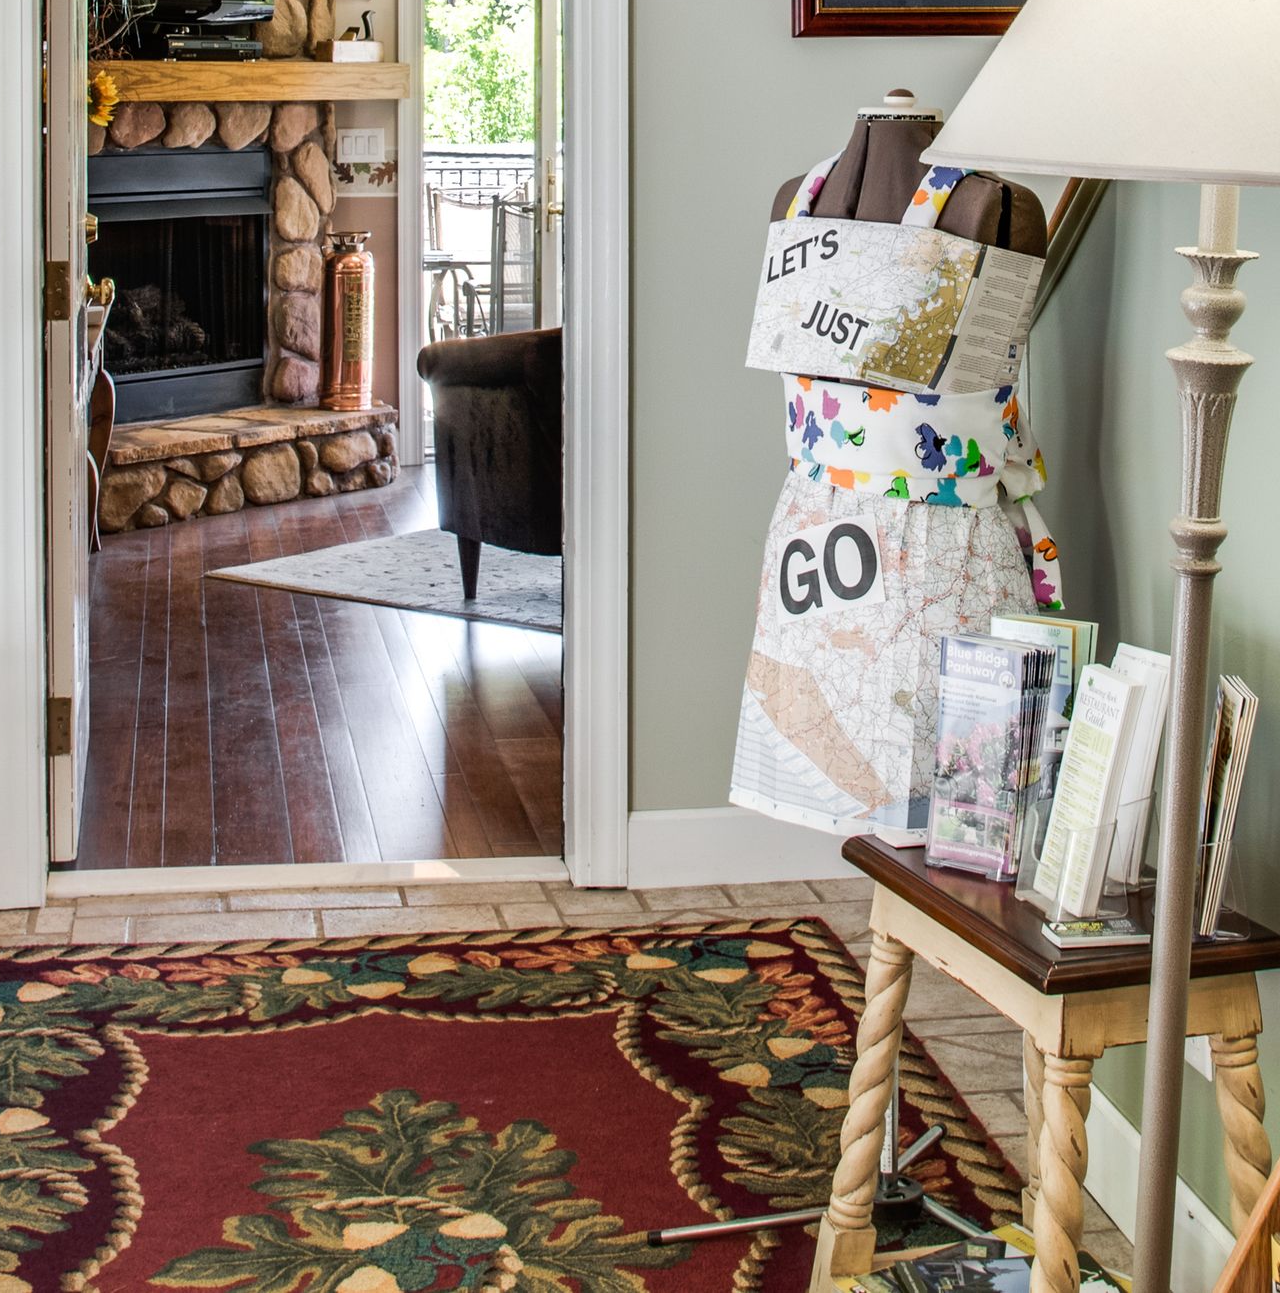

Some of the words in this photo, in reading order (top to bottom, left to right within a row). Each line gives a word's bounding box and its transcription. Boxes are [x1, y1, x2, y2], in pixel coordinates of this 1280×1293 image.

[766, 229, 840, 283] LET'S
[801, 300, 869, 352] JUST
[779, 523, 878, 615] GO
[947, 644, 972, 660] Blue
[975, 650, 1009, 668] Ridge
[946, 659, 997, 681] Parkway
[1080, 692, 1119, 719] RESTAURANT
[1085, 707, 1106, 729] Guide
